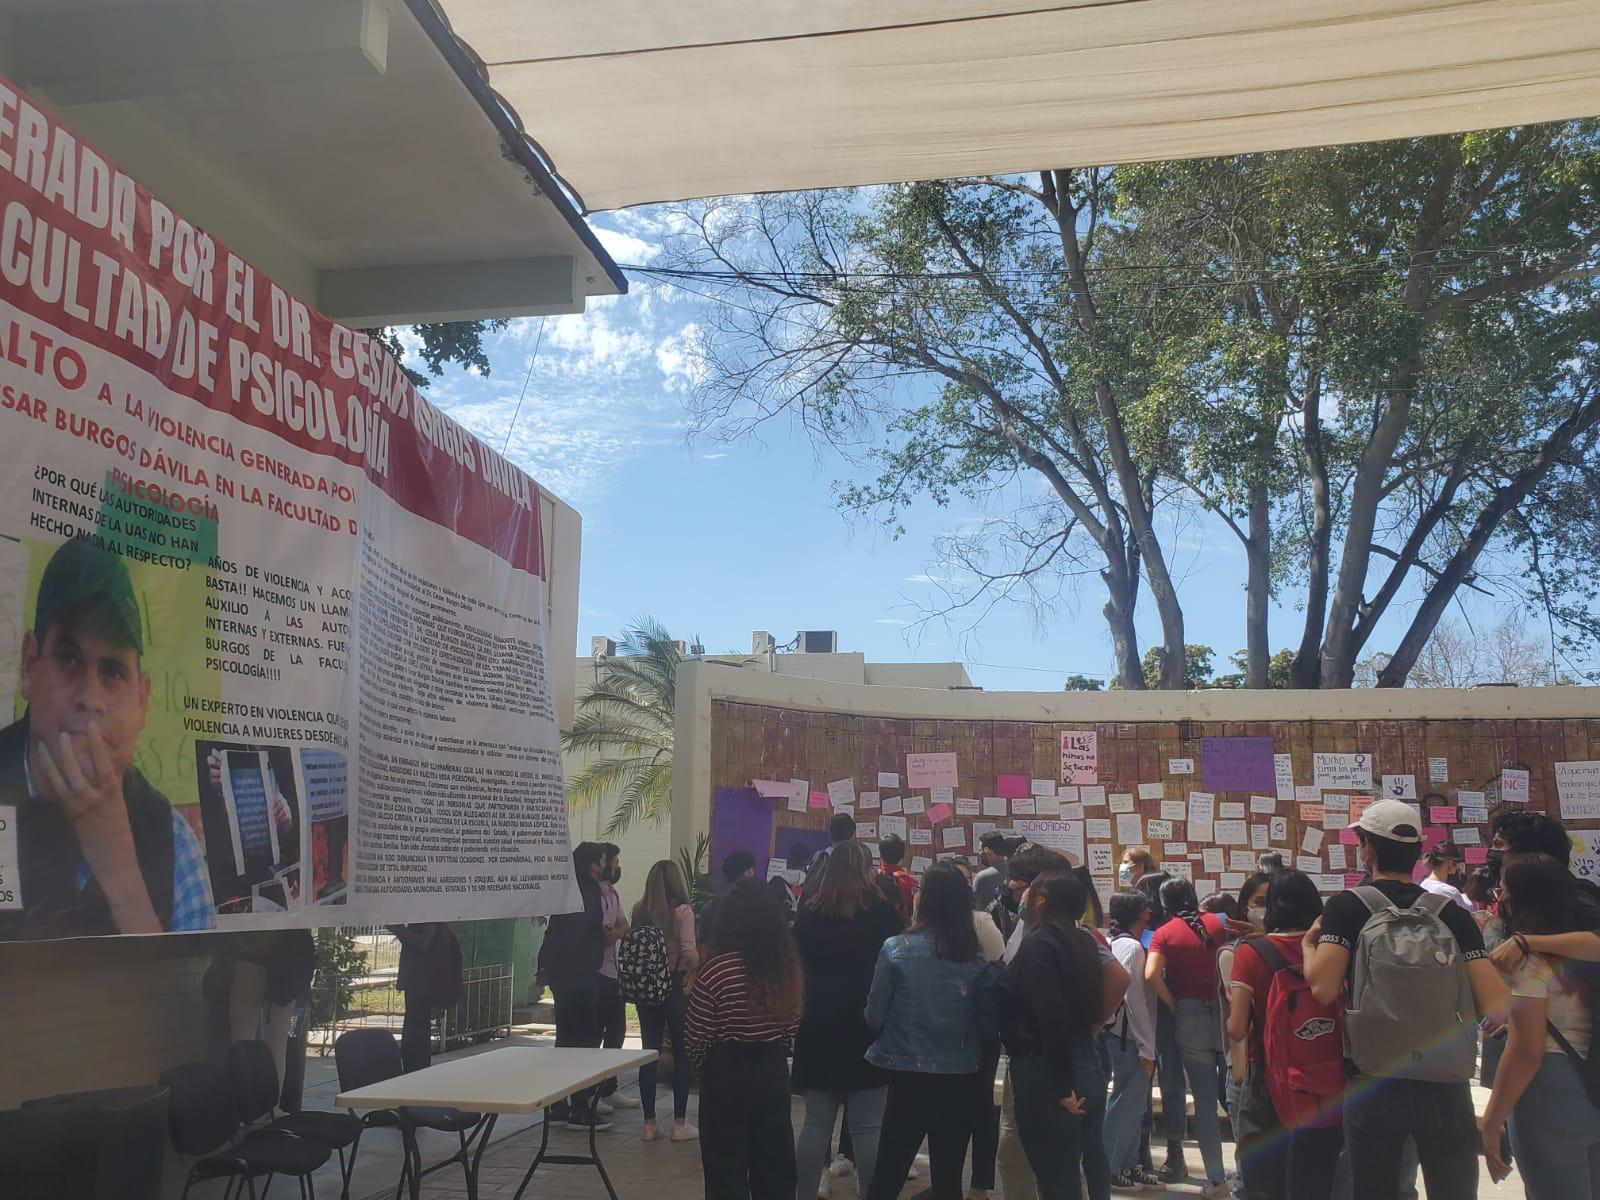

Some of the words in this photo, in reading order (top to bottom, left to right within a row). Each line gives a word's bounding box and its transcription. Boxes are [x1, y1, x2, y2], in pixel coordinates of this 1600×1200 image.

[149, 198, 215, 305] POR
[226, 252, 260, 333] EL
[271, 283, 320, 368] DR.
[173, 305, 219, 392] DE
[0, 385, 47, 423] SAR
[55, 408, 137, 461] BURGOS
[139, 443, 209, 488] DÁVILA
[215, 473, 235, 498] EN
[240, 484, 263, 507] LA
[268, 493, 341, 532] FACULTAD
[349, 519, 358, 535] D
[97, 382, 113, 406] A
[125, 394, 143, 421] LA
[148, 405, 235, 461] VIOLENCIA
[240, 449, 328, 495] GENERADA
[331, 481, 356, 504] PO
[32, 487, 94, 521] INTERNAS
[94, 510, 107, 527] DE
[108, 517, 121, 533] LA
[124, 522, 147, 541] UAS
[149, 530, 167, 546] NO
[171, 536, 199, 552] HAN
[34, 466, 66, 488] ¿POR
[70, 478, 97, 498] QUÉ
[99, 488, 114, 506] LAS
[115, 497, 197, 532] AUTORIDADES
[111, 466, 220, 523] PSICOLOGÍA
[30, 512, 74, 538] HECHO
[77, 527, 105, 549] NADA
[108, 539, 124, 555] AL
[126, 545, 192, 571] RESPECTO?
[205, 575, 247, 596] BASTA!!
[252, 586, 296, 609] HACEMOS
[300, 599, 316, 613] UN
[321, 603, 349, 617] LLAM
[207, 555, 238, 574] AÑOS
[245, 565, 260, 579] DE
[263, 571, 310, 594] VIOLENCIA
[317, 585, 323, 596] Y
[331, 587, 352, 601] ACO
[205, 596, 249, 615] AUXILIO
[264, 609, 271, 622] A
[286, 615, 304, 629] LAS
[321, 621, 348, 635] AUTO
[205, 616, 258, 637] INTERNAS
[261, 627, 267, 640] Y
[269, 631, 324, 650] EXTERNAS.
[327, 639, 347, 652] FUE
[205, 637, 250, 656] BURGOS
[263, 648, 275, 662] DE
[289, 653, 304, 666] LA
[318, 657, 345, 670] FACU
[205, 657, 281, 681] PSICOLOGÍA!!!!
[183, 695, 199, 709] UN
[201, 698, 248, 717] EXPERTO
[250, 705, 264, 719] EN
[266, 707, 324, 723] VIOLENCIA
[183, 717, 239, 736] VIOLENCIA
[242, 726, 250, 736] A
[252, 725, 303, 741] MUJERES
[304, 729, 333, 743] DESDE
